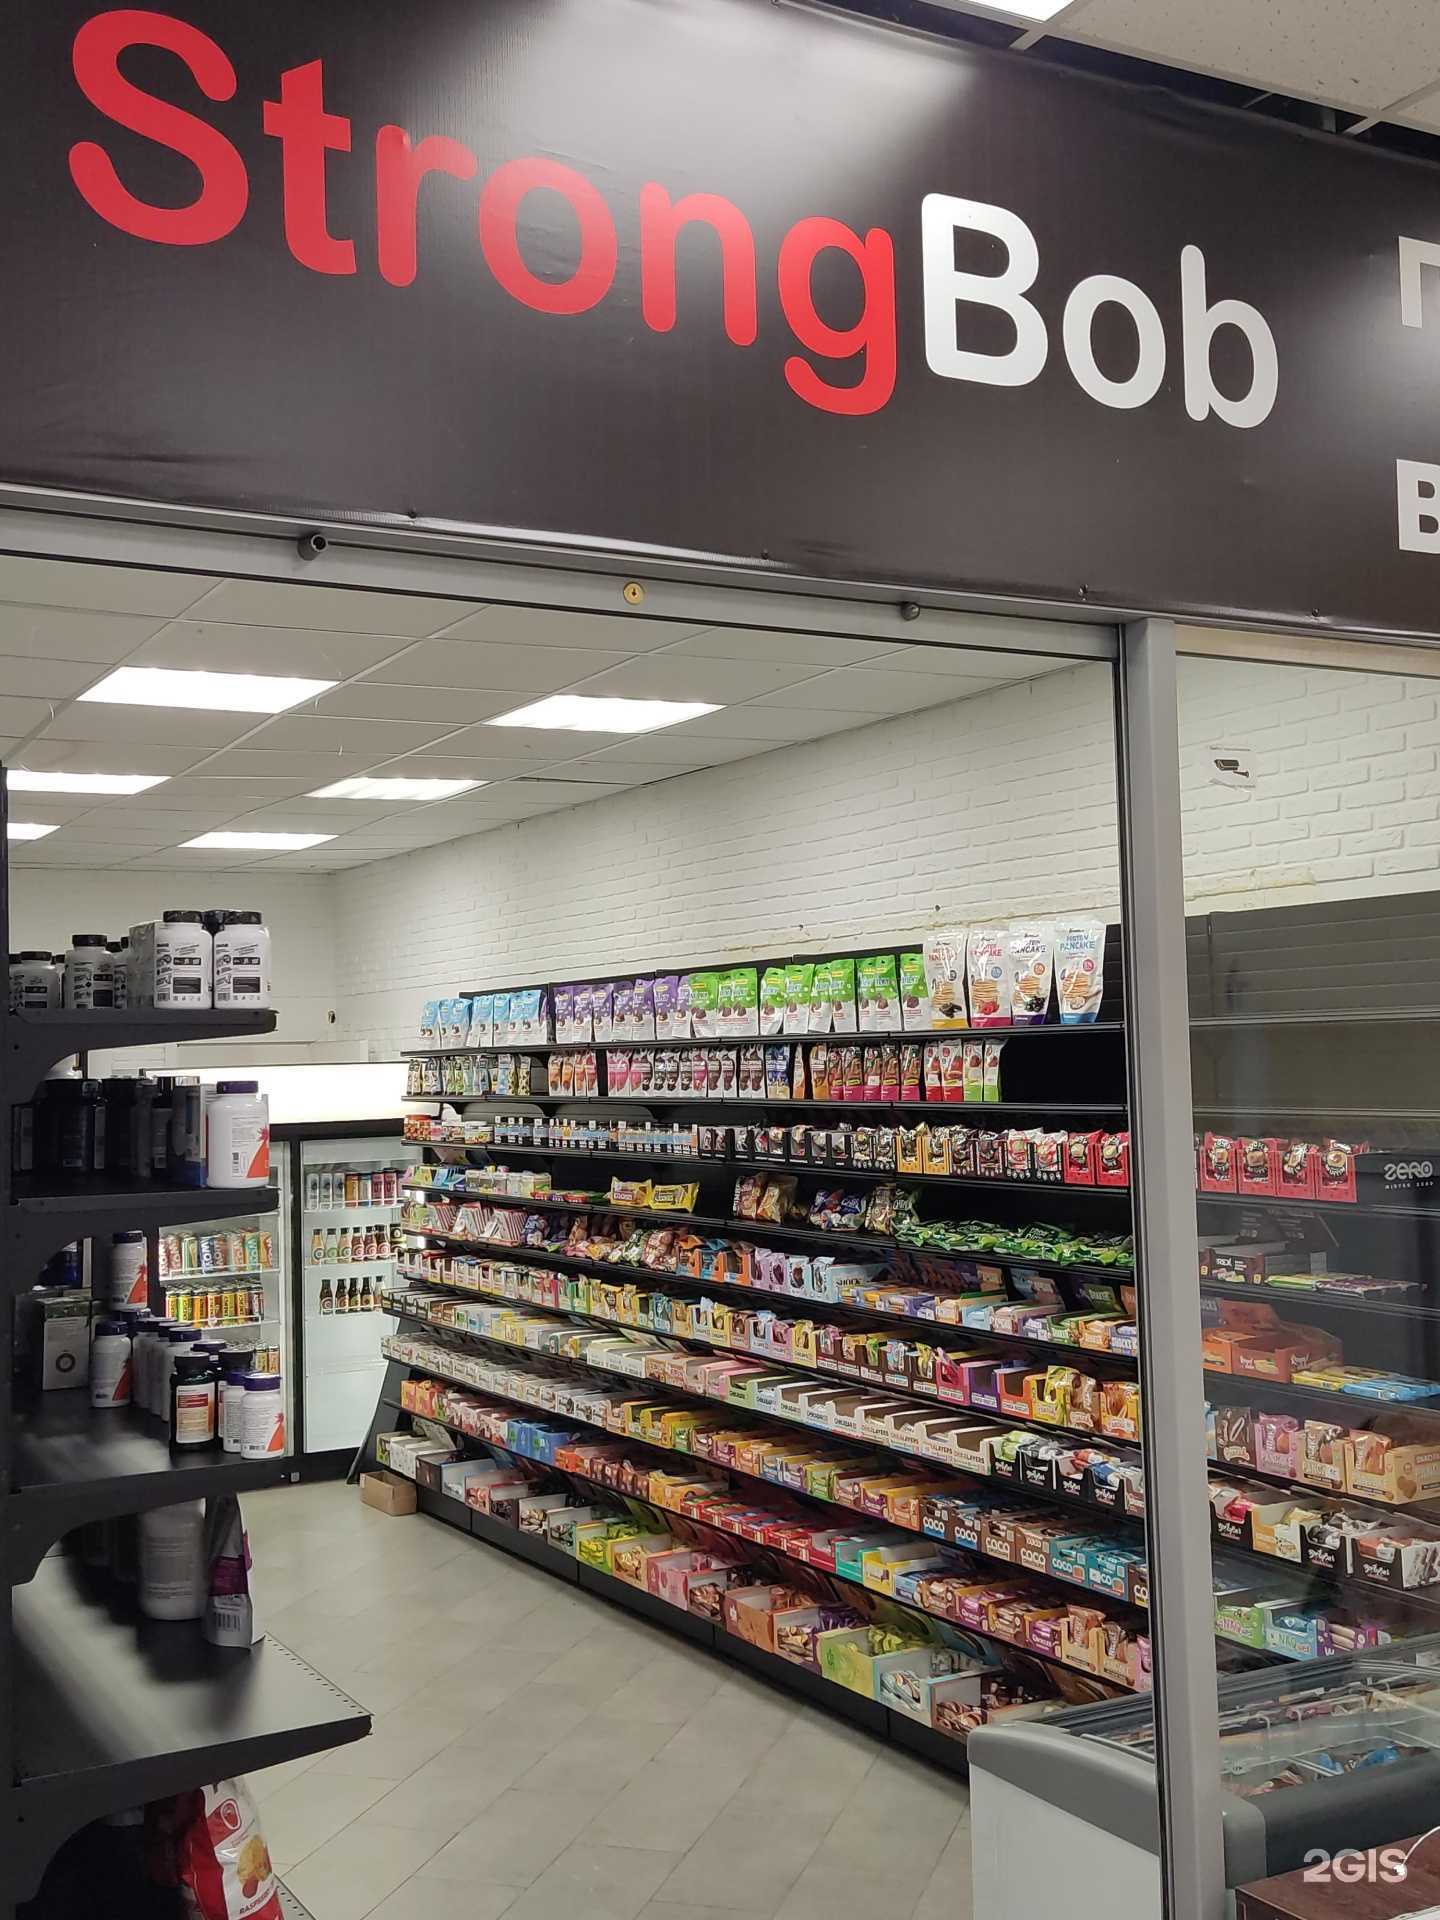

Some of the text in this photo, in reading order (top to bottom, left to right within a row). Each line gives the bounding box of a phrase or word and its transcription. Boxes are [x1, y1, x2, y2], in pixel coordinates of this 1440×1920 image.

[69, 9, 1279, 430] StrongBob
[923, 1516, 945, 1531] COCO
[954, 1526, 977, 1542] COCO
[985, 1536, 1010, 1552] COCO
[1020, 1547, 1045, 1564] COCO
[1051, 1557, 1073, 1573] COCO
